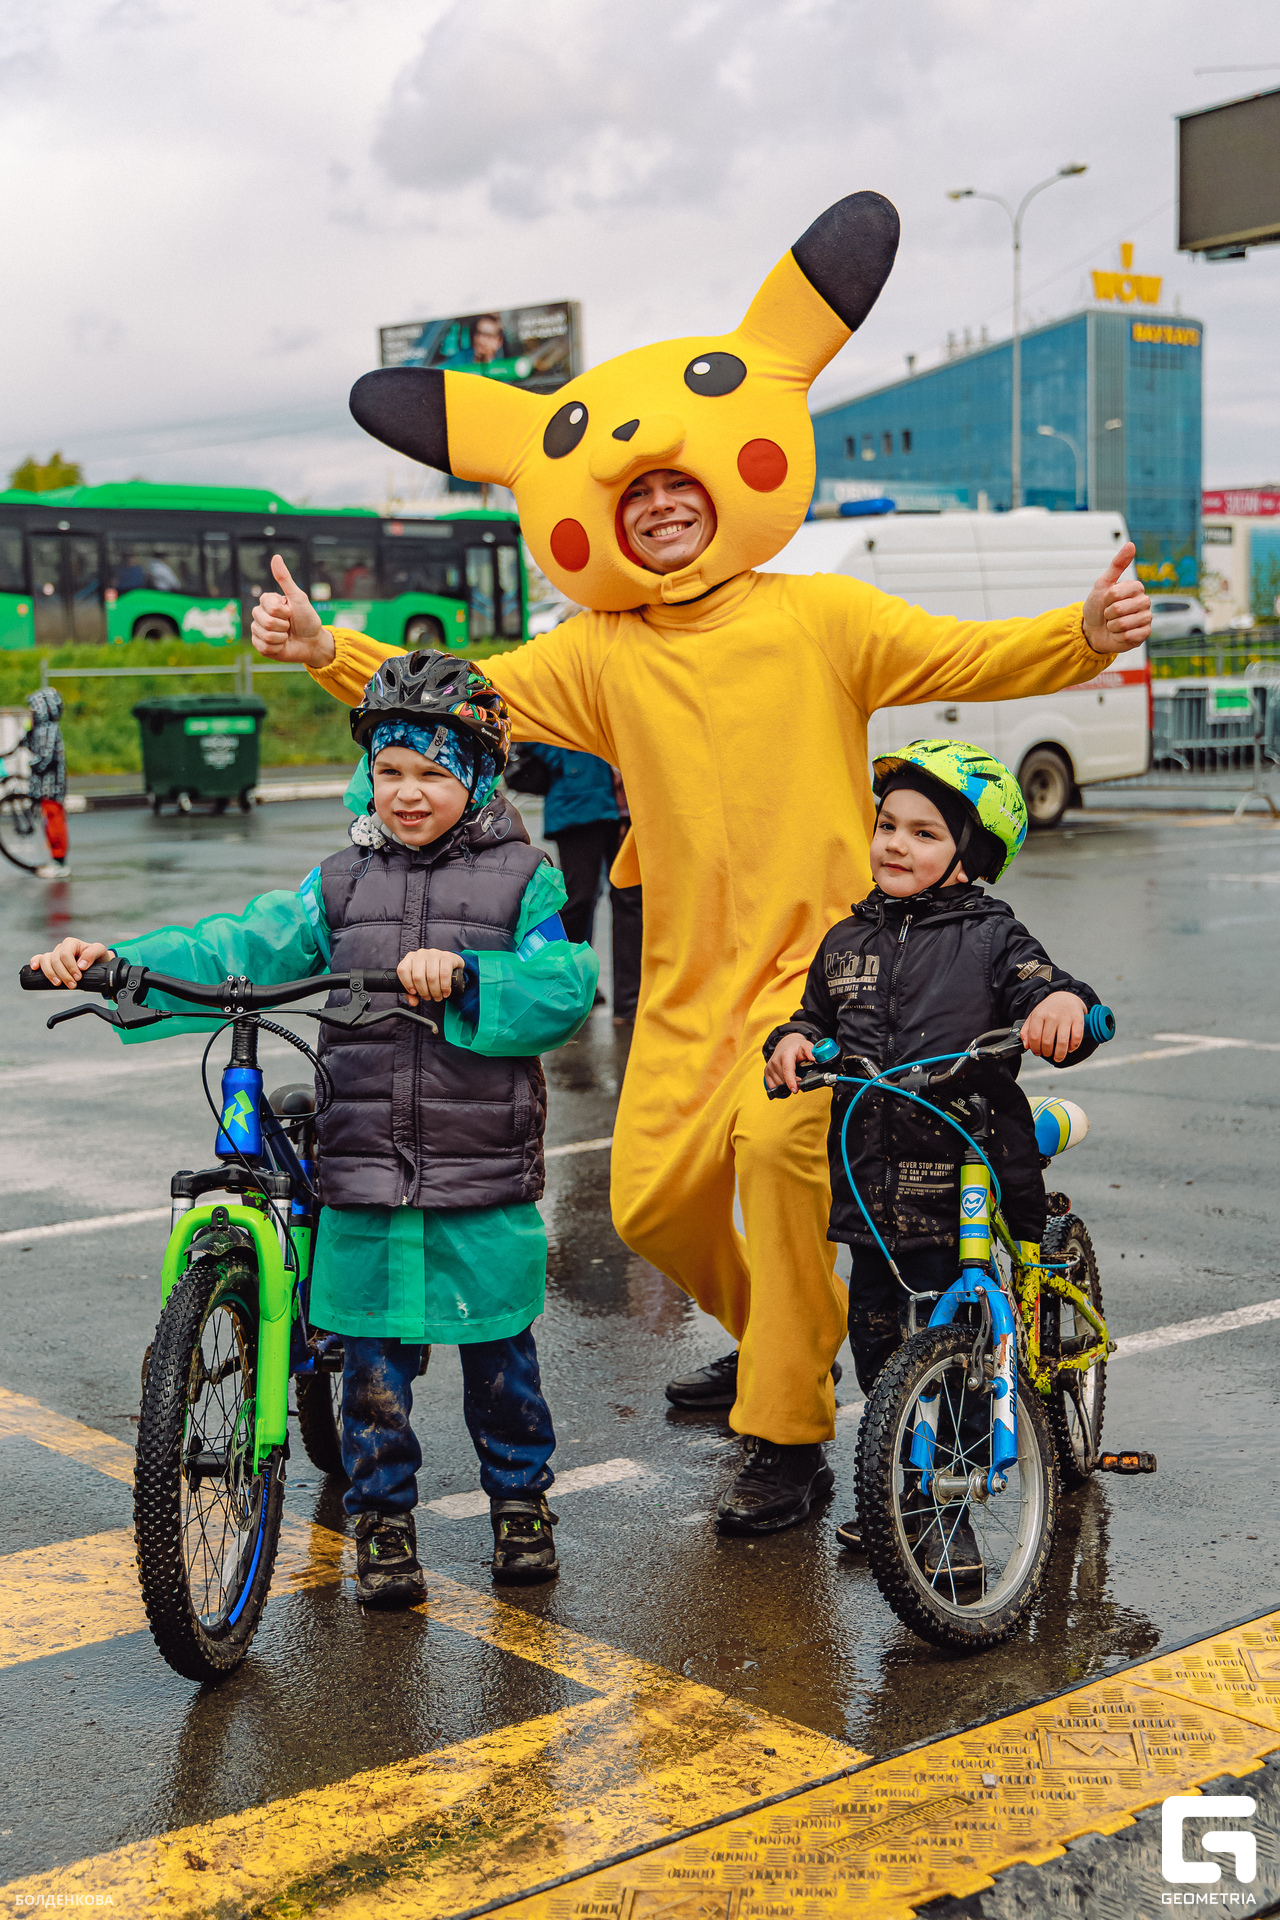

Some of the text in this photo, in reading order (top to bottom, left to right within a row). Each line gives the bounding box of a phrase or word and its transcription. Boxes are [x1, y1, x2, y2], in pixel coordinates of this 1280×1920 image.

[825, 951, 880, 978] Urbn
[919, 1162, 933, 1170] STOP
[1046, 1466, 1055, 1532] SCHWALBE
